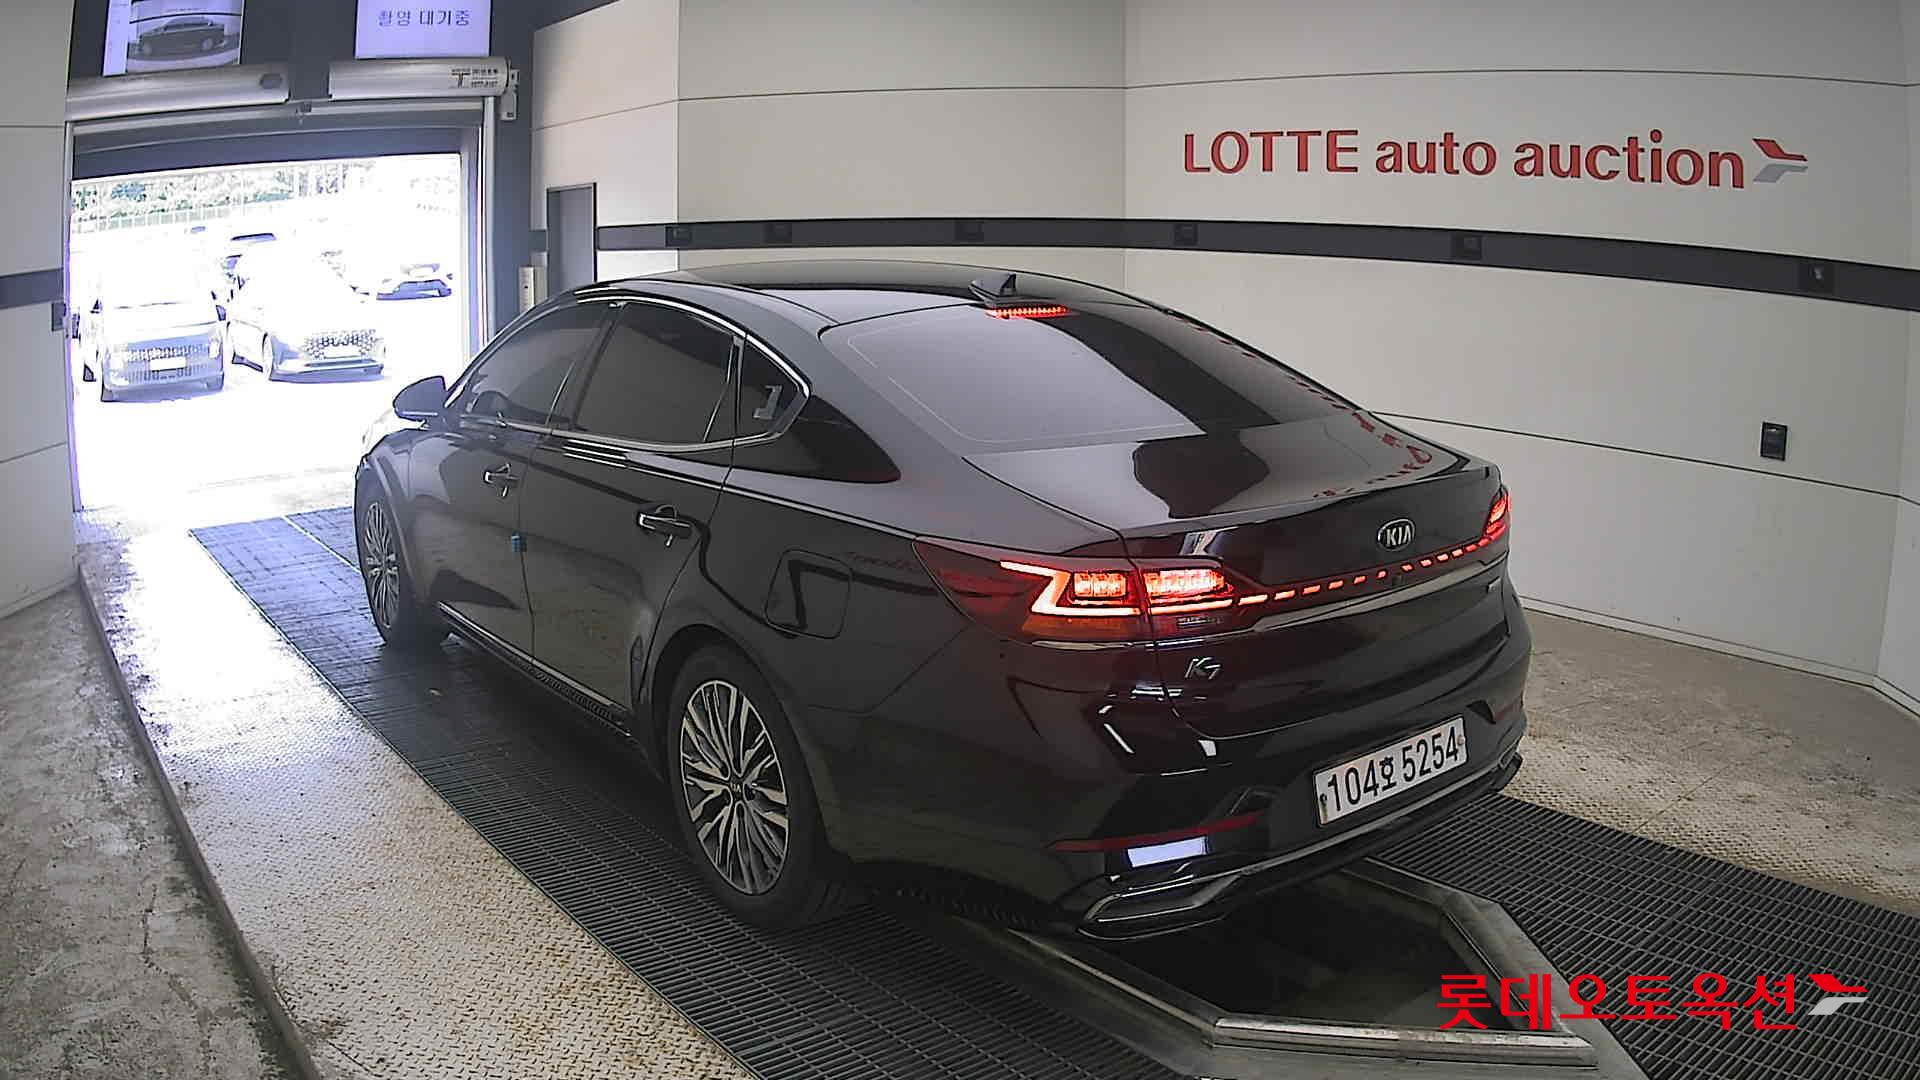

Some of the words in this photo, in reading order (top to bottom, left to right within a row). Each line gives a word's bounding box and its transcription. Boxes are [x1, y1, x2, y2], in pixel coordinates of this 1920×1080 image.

[419, 9, 470, 26] 대기중
[1185, 130, 1358, 174] LOTTE
[1376, 132, 1497, 174] auto
[1514, 129, 1745, 188] auction
[1386, 525, 1411, 546] KIA
[1185, 656, 1221, 680] K7
